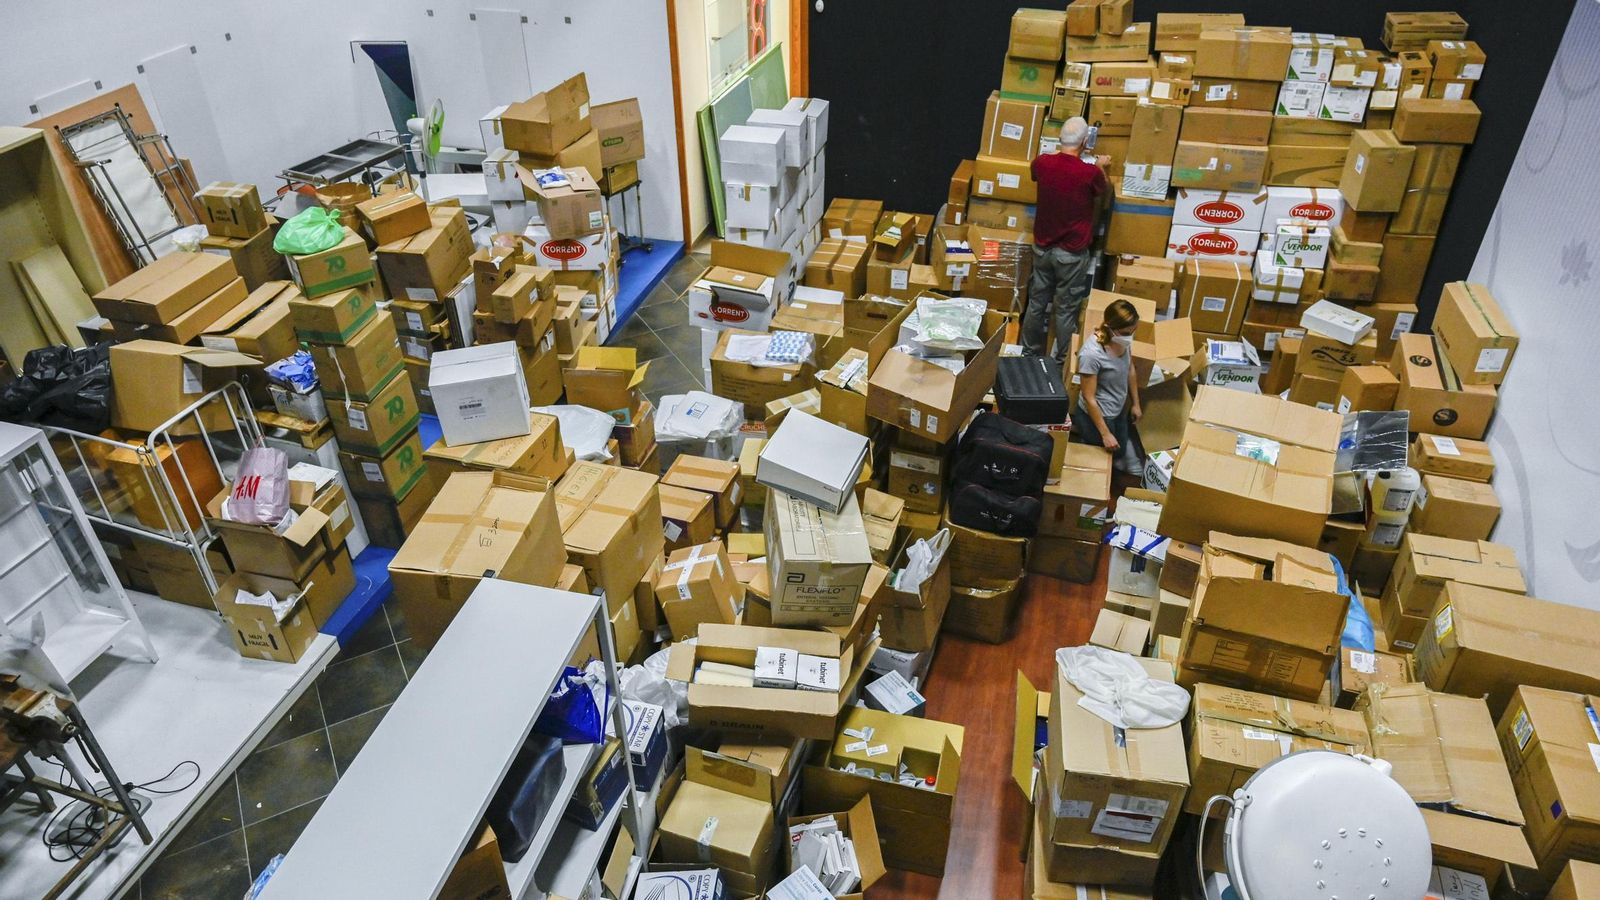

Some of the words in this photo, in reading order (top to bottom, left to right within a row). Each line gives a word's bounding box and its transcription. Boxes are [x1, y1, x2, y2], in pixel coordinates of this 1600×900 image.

[1199, 207, 1239, 220] TORRENT
[544, 244, 582, 254] TORRENT
[1287, 242, 1322, 252] VENDOR
[714, 305, 745, 317] ORRENT
[1217, 373, 1254, 383] VENDOR
[646, 708, 656, 725] COPY
